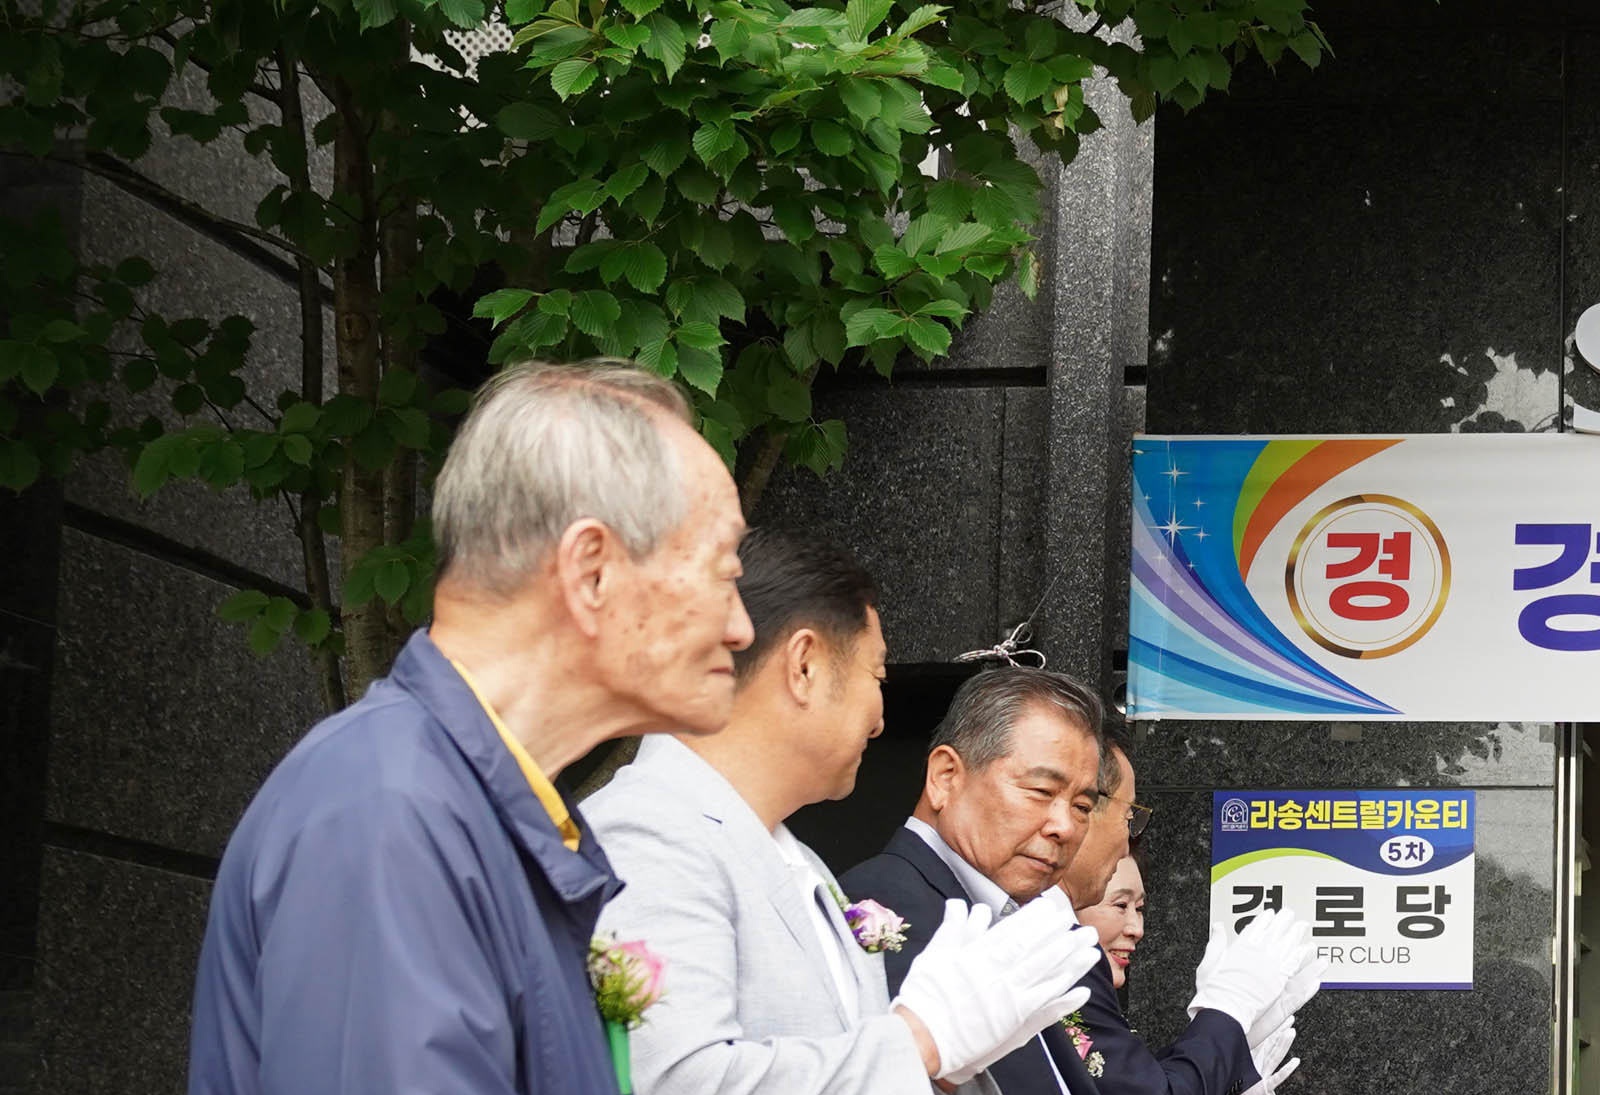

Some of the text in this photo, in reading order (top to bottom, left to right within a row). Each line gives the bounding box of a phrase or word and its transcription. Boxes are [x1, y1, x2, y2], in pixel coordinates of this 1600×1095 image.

[1325, 531, 1412, 621] 경
[1250, 799, 1468, 830] 라송센트럴카운티
[1387, 842, 1426, 863] 5차
[1349, 946, 1411, 965] CLUB
